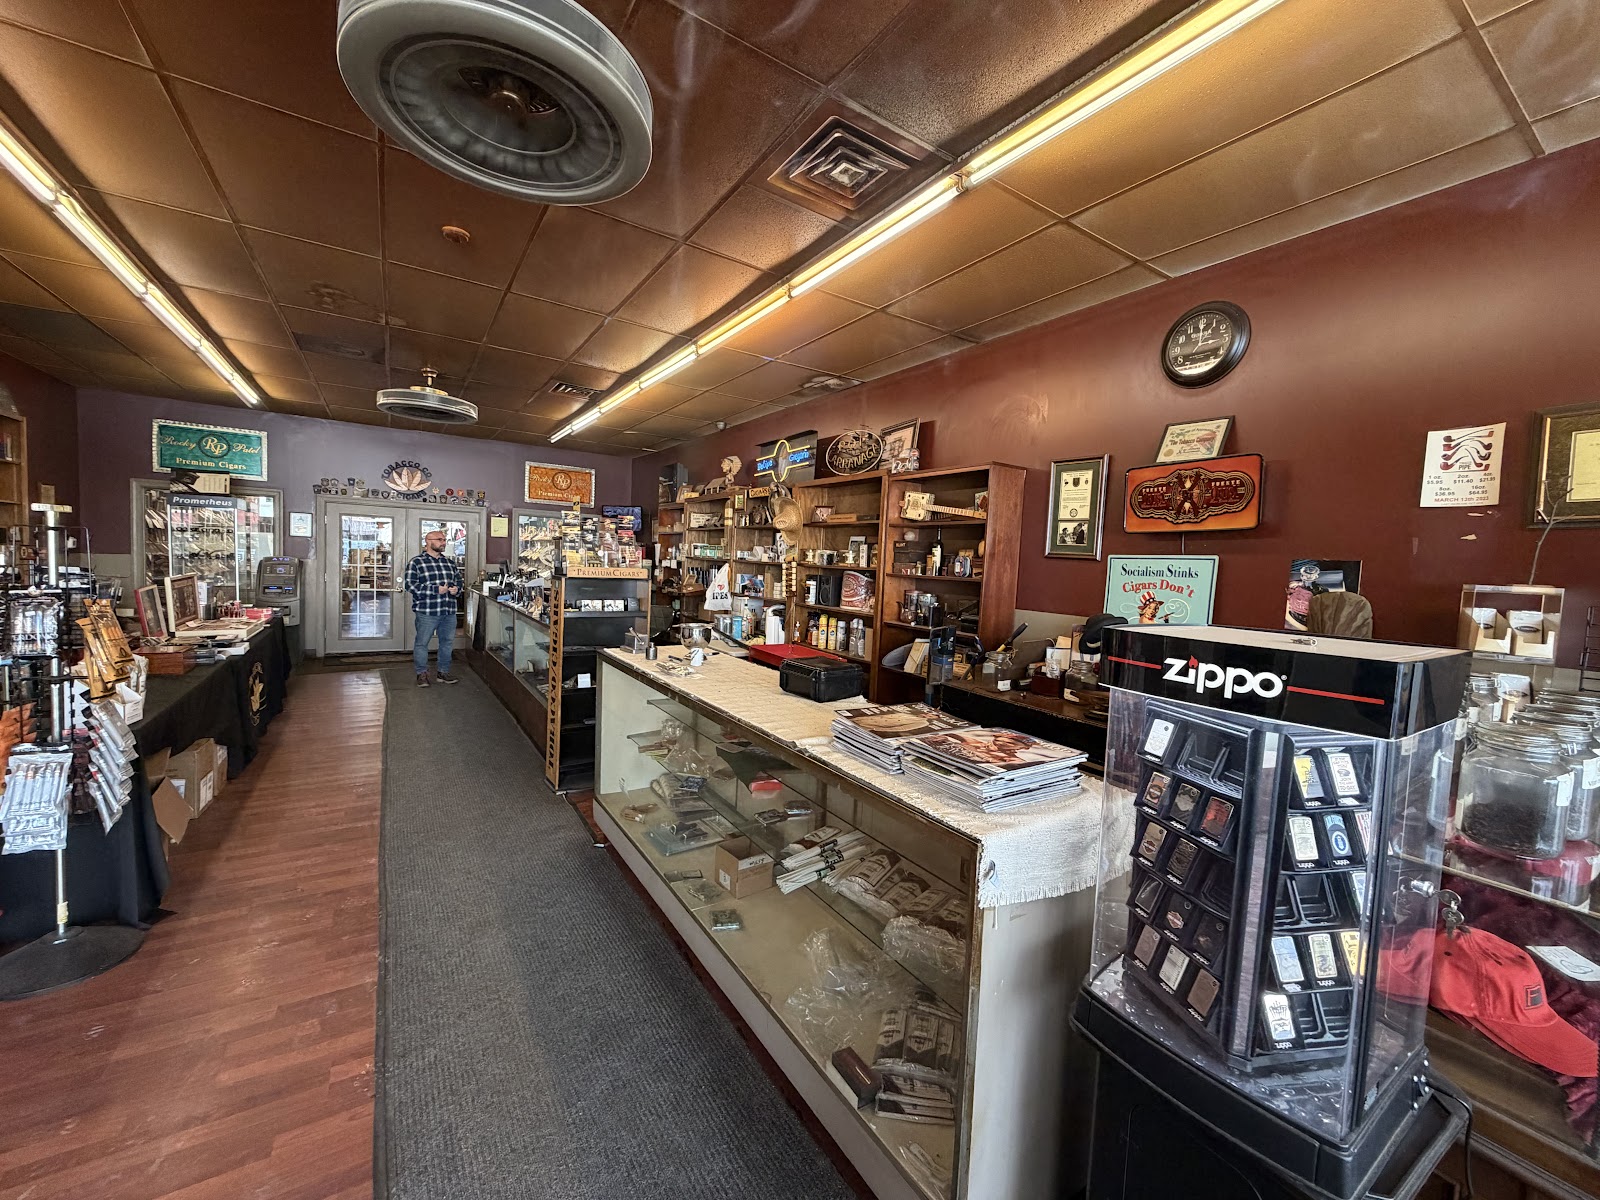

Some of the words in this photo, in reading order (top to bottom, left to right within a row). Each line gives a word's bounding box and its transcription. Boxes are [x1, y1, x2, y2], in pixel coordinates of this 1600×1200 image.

[1179, 335, 1186, 344] 10
[1177, 356, 1183, 364] 8
[160, 435, 197, 450] Rocky
[232, 443, 261, 454] Patel
[175, 457, 216, 467] Premium
[218, 461, 247, 470] Cigars
[381, 460, 421, 480] TOBACCO
[396, 490, 427, 500] CIGARS
[538, 490, 563, 498] Premium
[172, 496, 233, 507] Prometheus
[577, 568, 612, 577] PREMIUM
[612, 569, 640, 577] CIGARS
[1120, 563, 1165, 577] Socialism
[1165, 563, 1199, 578] Stinks
[1122, 581, 1158, 593] Cigars
[1159, 579, 1195, 598] Don't
